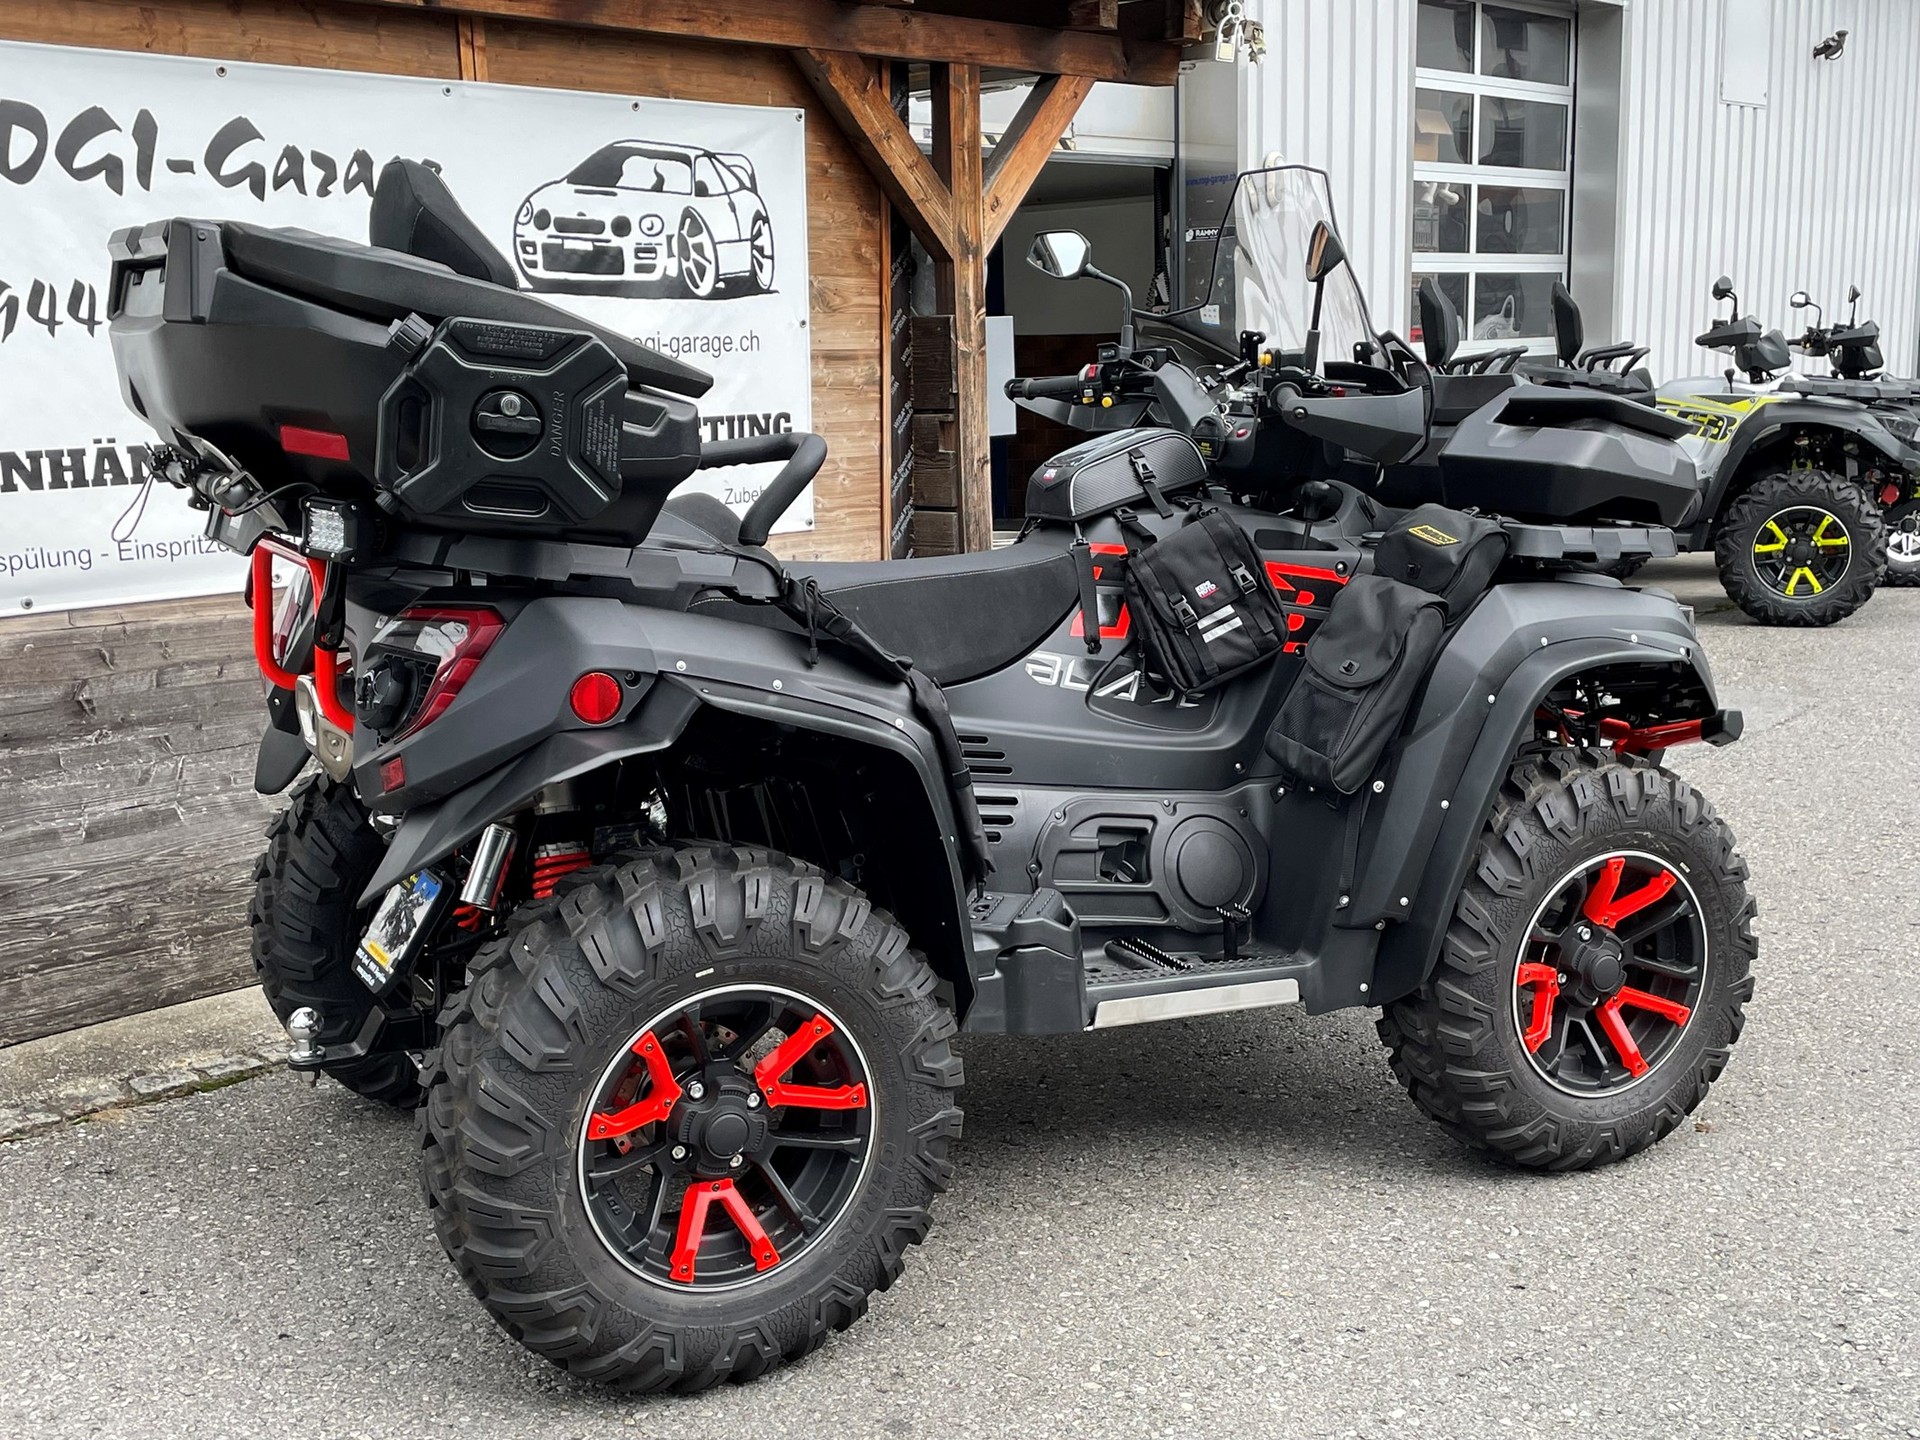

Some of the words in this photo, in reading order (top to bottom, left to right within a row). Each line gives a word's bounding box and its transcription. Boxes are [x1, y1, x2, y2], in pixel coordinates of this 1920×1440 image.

[0, 99, 442, 202] OGI-Gara
[550, 390, 566, 458] DANGER
[698, 411, 793, 443] TUNG
[0, 547, 93, 577] spülung
[118, 535, 230, 561] Einspritz
[1025, 650, 1205, 708] BLA
